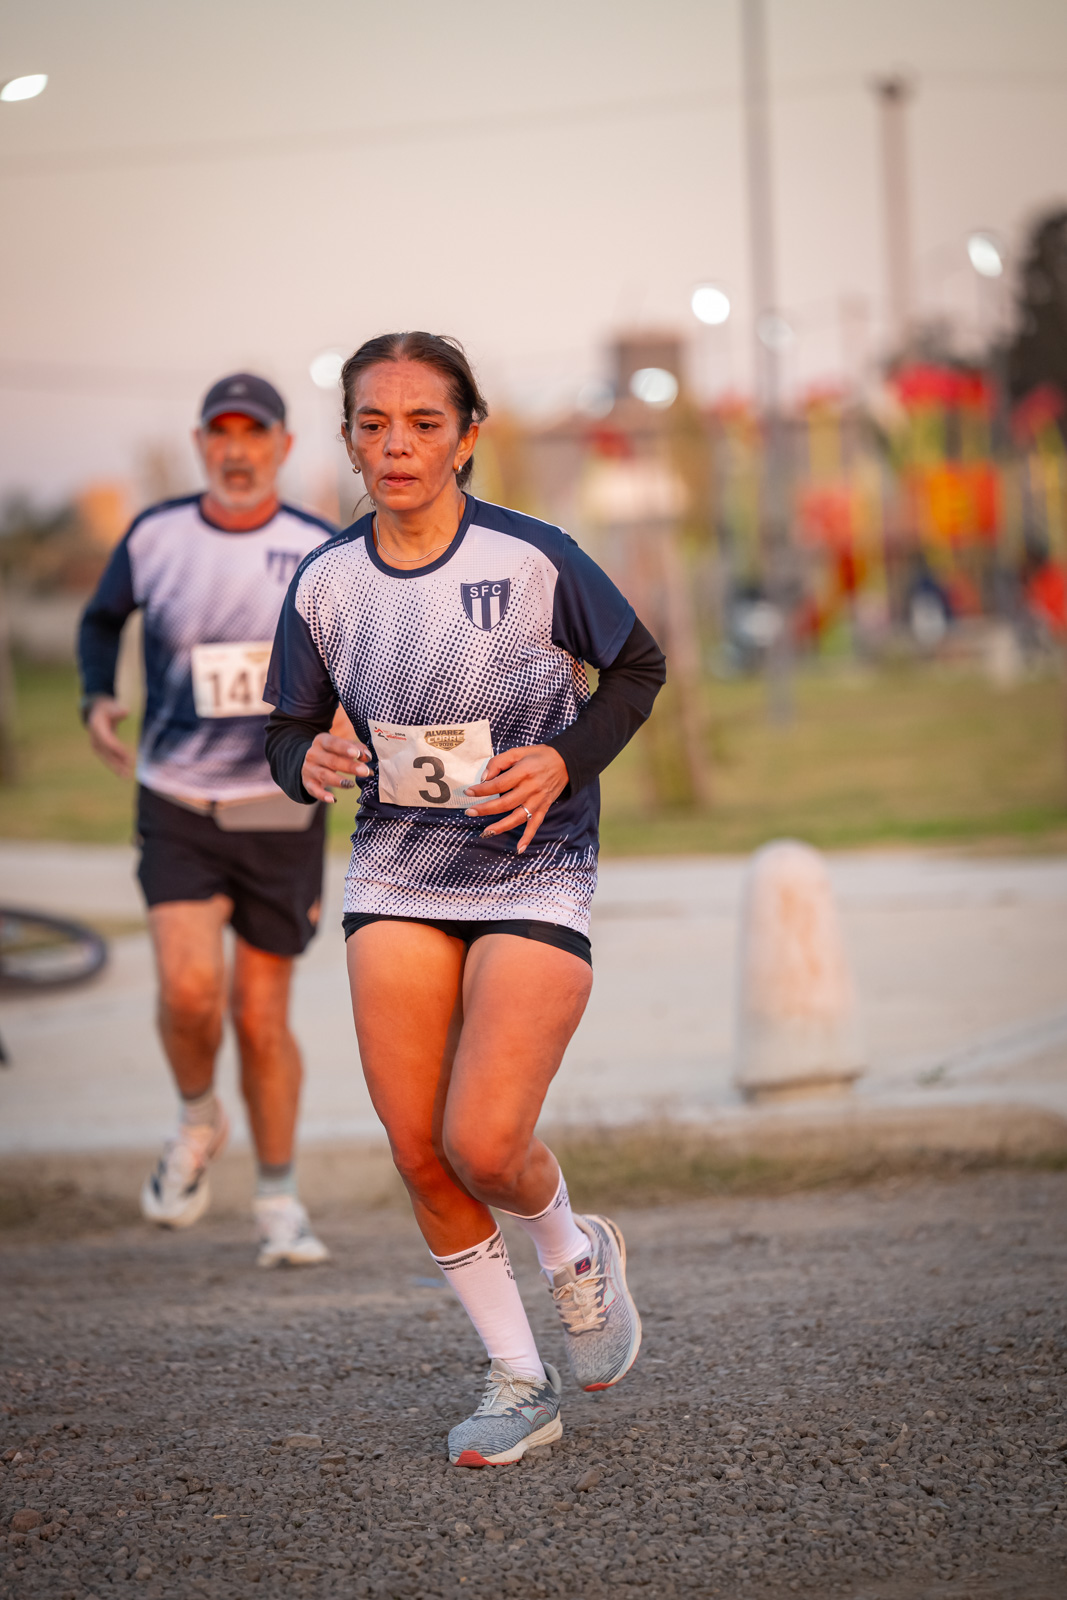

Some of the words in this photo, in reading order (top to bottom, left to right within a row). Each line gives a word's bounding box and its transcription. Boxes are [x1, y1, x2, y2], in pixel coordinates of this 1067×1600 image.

[470, 584, 502, 598] SFC
[425, 729, 465, 738] ALVAREZ
[427, 735, 465, 743] CORRE
[412, 756, 451, 804] 3
